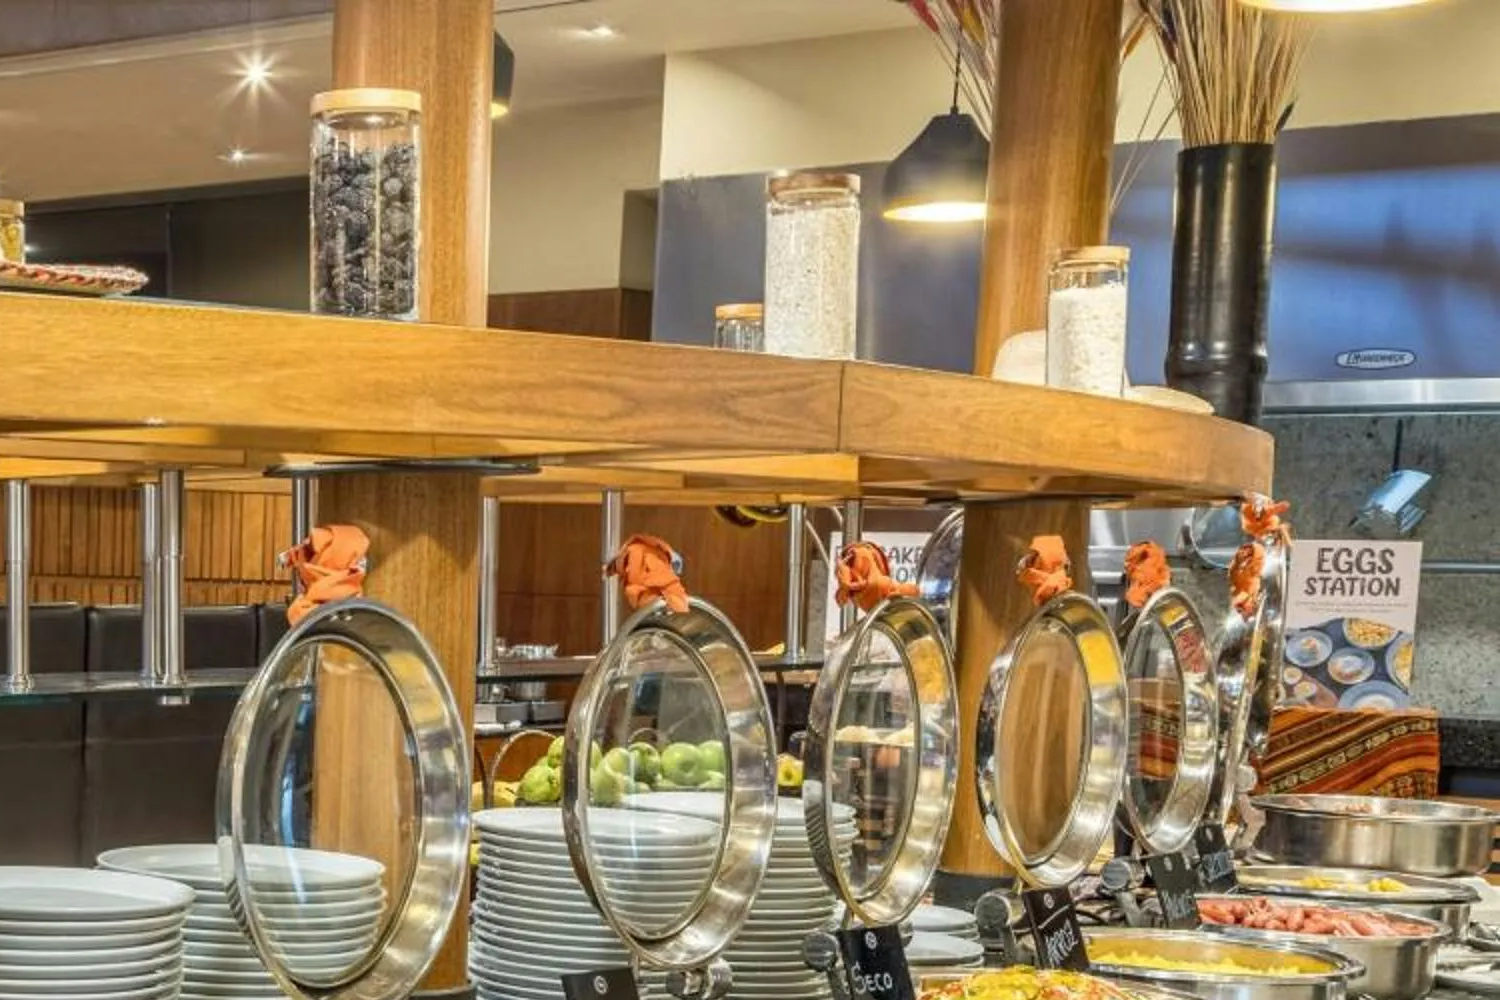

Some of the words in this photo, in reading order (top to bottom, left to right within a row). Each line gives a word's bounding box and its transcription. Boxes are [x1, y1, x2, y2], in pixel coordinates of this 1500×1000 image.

[1316, 547, 1395, 574] EGGS
[1304, 577, 1400, 597] STATION
[851, 961, 893, 994] SECO
